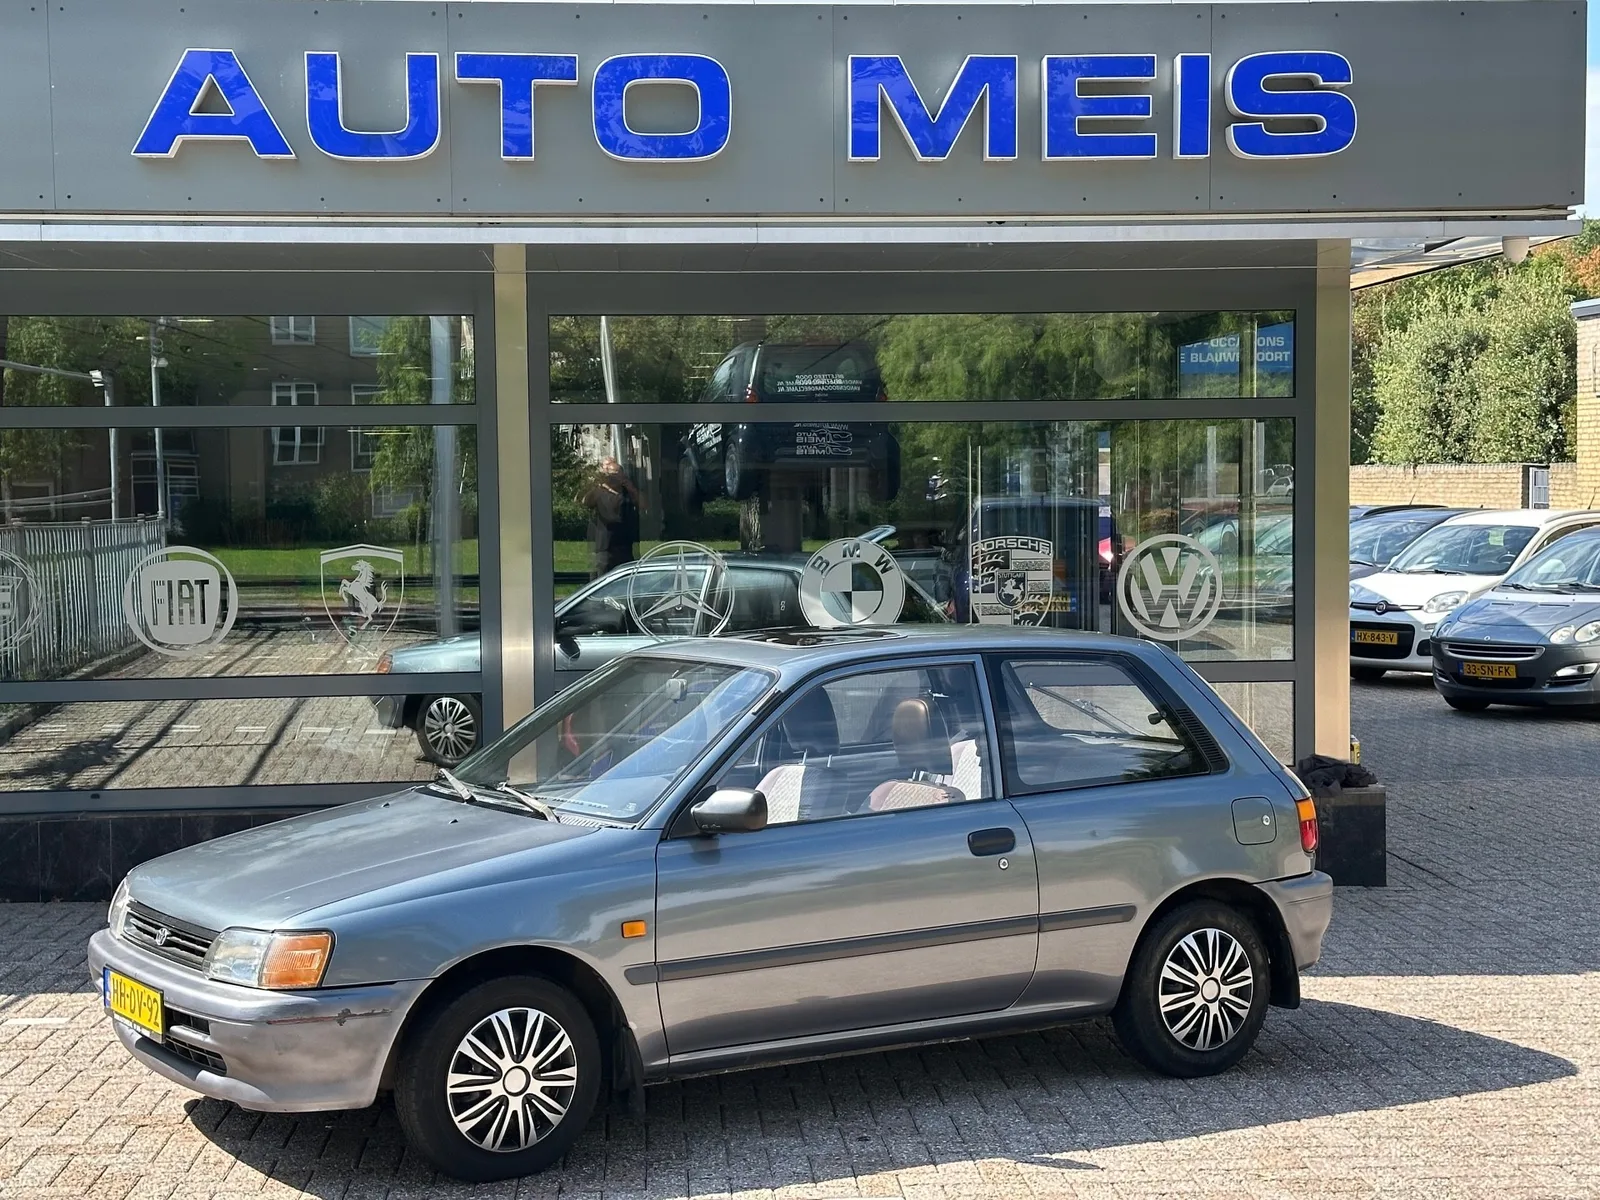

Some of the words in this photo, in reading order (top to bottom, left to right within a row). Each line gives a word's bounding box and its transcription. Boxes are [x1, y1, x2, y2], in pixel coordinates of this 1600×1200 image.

[131, 48, 733, 162] AUTO
[847, 51, 1357, 161] MEIS
[1256, 351, 1291, 362] OORT
[973, 538, 1050, 554] PORSCHE
[810, 541, 893, 579] BMW
[150, 579, 210, 626] FIAT
[1356, 631, 1395, 643] HX-843-V
[1466, 664, 1511, 677] 33-SN-FK
